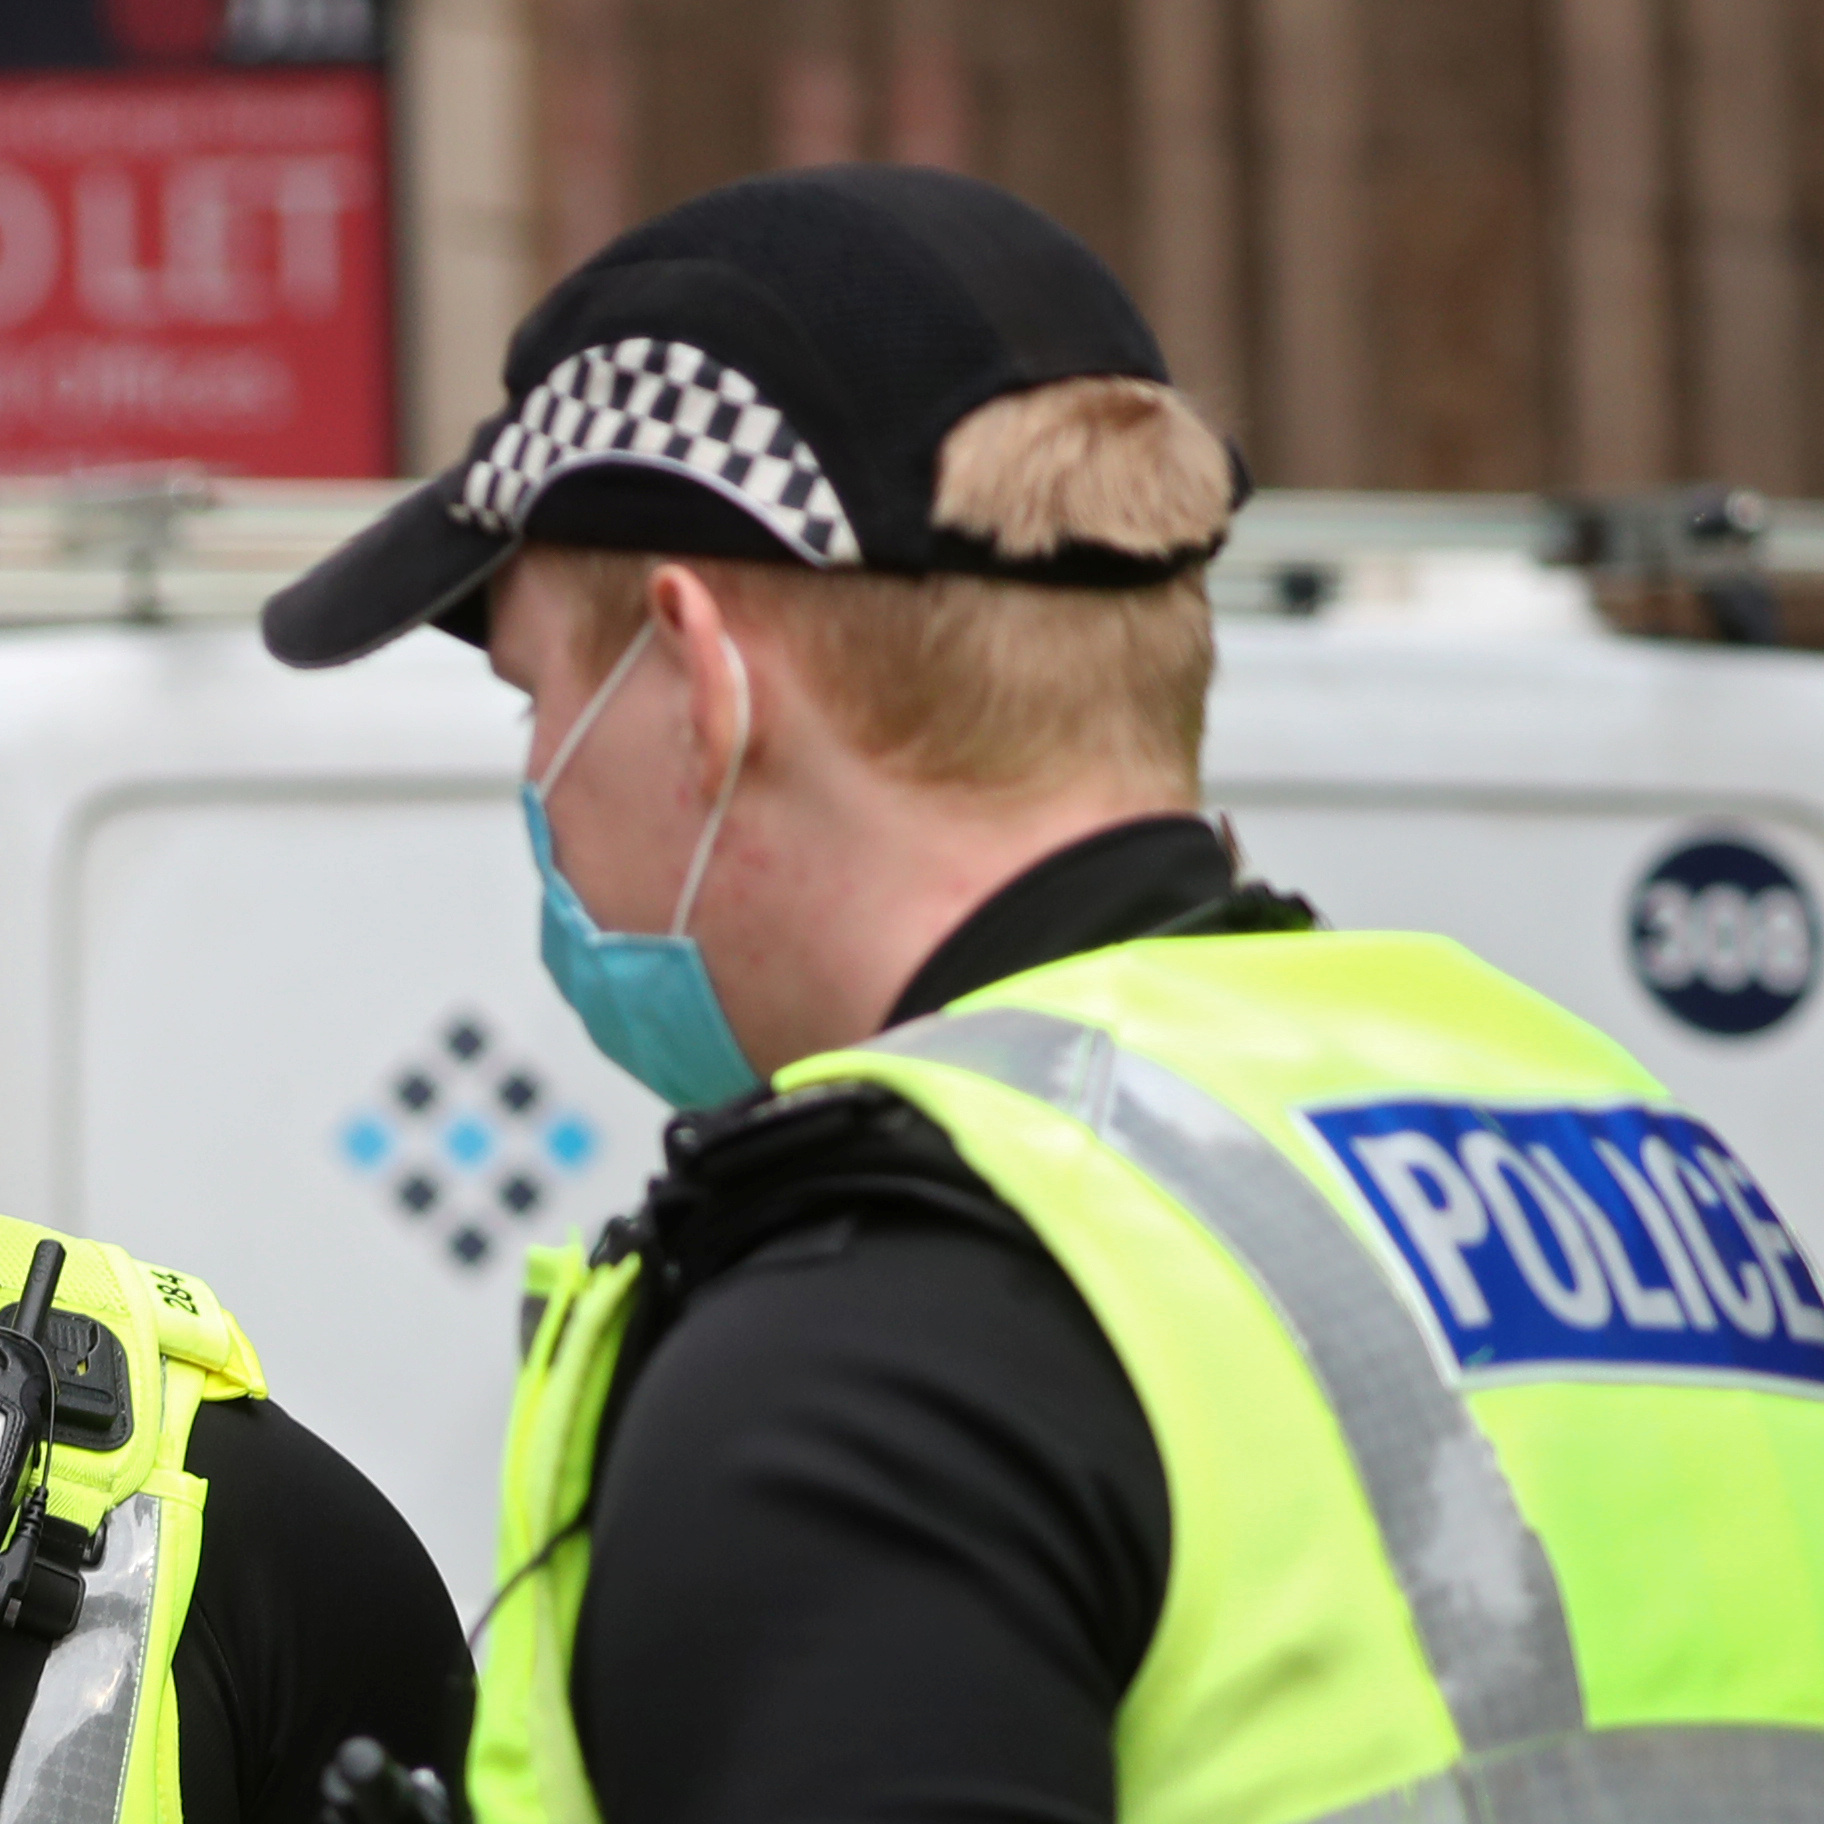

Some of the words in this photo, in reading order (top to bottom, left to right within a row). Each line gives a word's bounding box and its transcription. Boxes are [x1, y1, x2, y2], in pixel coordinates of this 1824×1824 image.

[72, 152, 382, 328] LET
[150, 1269, 200, 1316] 284
[1352, 1129, 1824, 1344] POLICE
